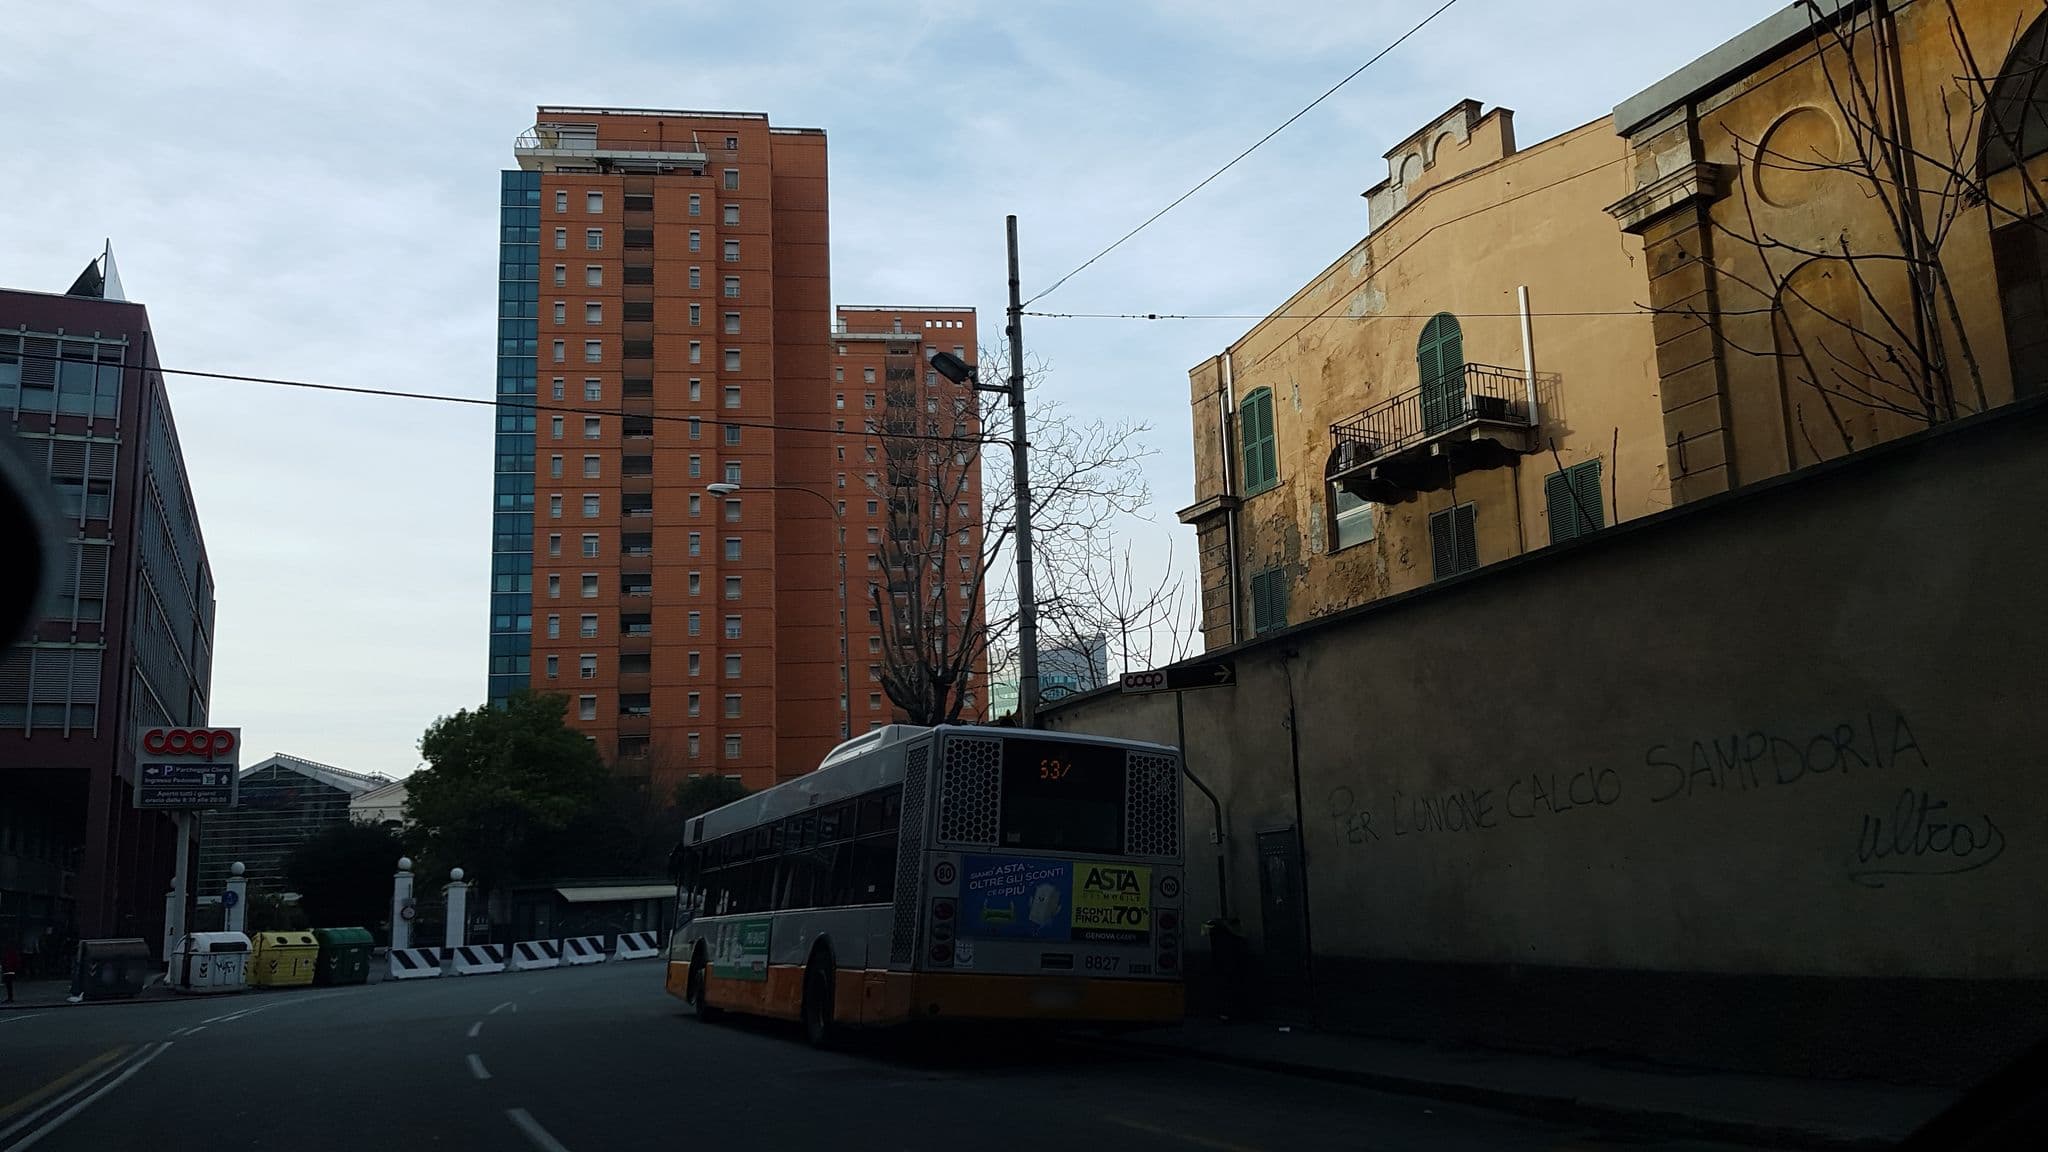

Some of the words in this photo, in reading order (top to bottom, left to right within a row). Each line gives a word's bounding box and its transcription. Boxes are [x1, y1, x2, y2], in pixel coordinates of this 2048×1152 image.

[1125, 672, 1163, 689] coop
[143, 729, 235, 761] coop
[1506, 766, 1622, 820] CALCIO
[1645, 711, 1930, 803] SAMPDORIA
[939, 867, 952, 880] 80
[969, 876, 1004, 890] OLTRE
[1006, 873, 1024, 885] GLI
[1025, 866, 1064, 881] SCONTI
[1083, 867, 1140, 892] ASTA
[1075, 906, 1112, 916] SCONTI
[1075, 914, 1100, 924] FINO
[1085, 955, 1120, 971] 8827
